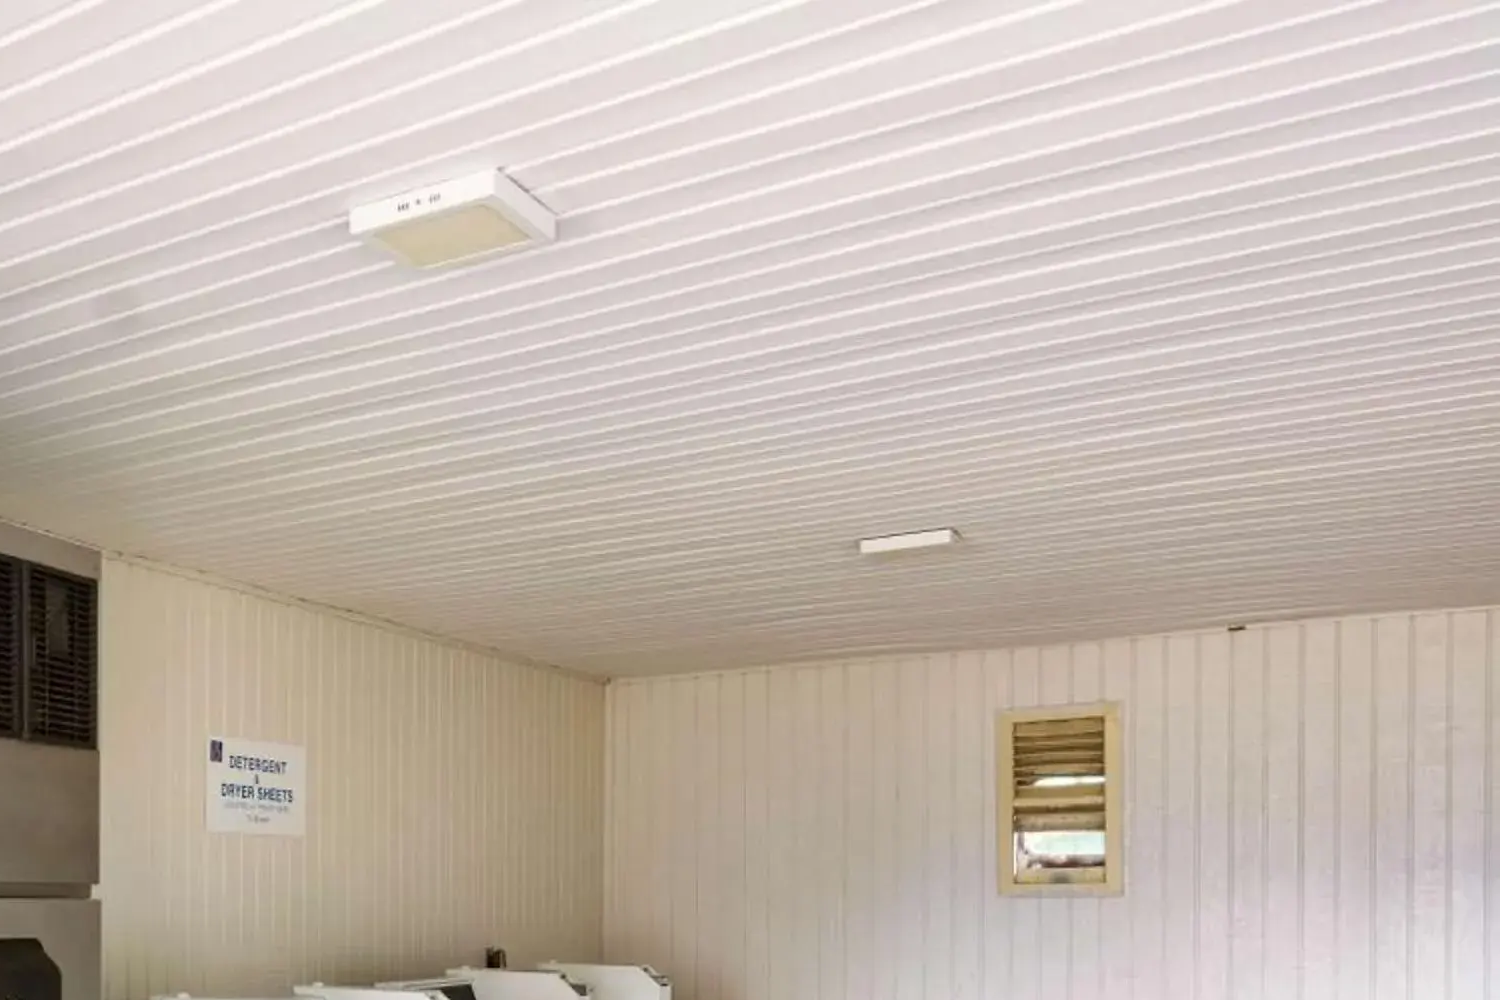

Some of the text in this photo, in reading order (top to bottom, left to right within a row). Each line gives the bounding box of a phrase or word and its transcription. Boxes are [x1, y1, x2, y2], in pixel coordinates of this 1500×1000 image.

[229, 755, 287, 774] DETERGENT
[220, 783, 294, 804] DRYER SHEETS
